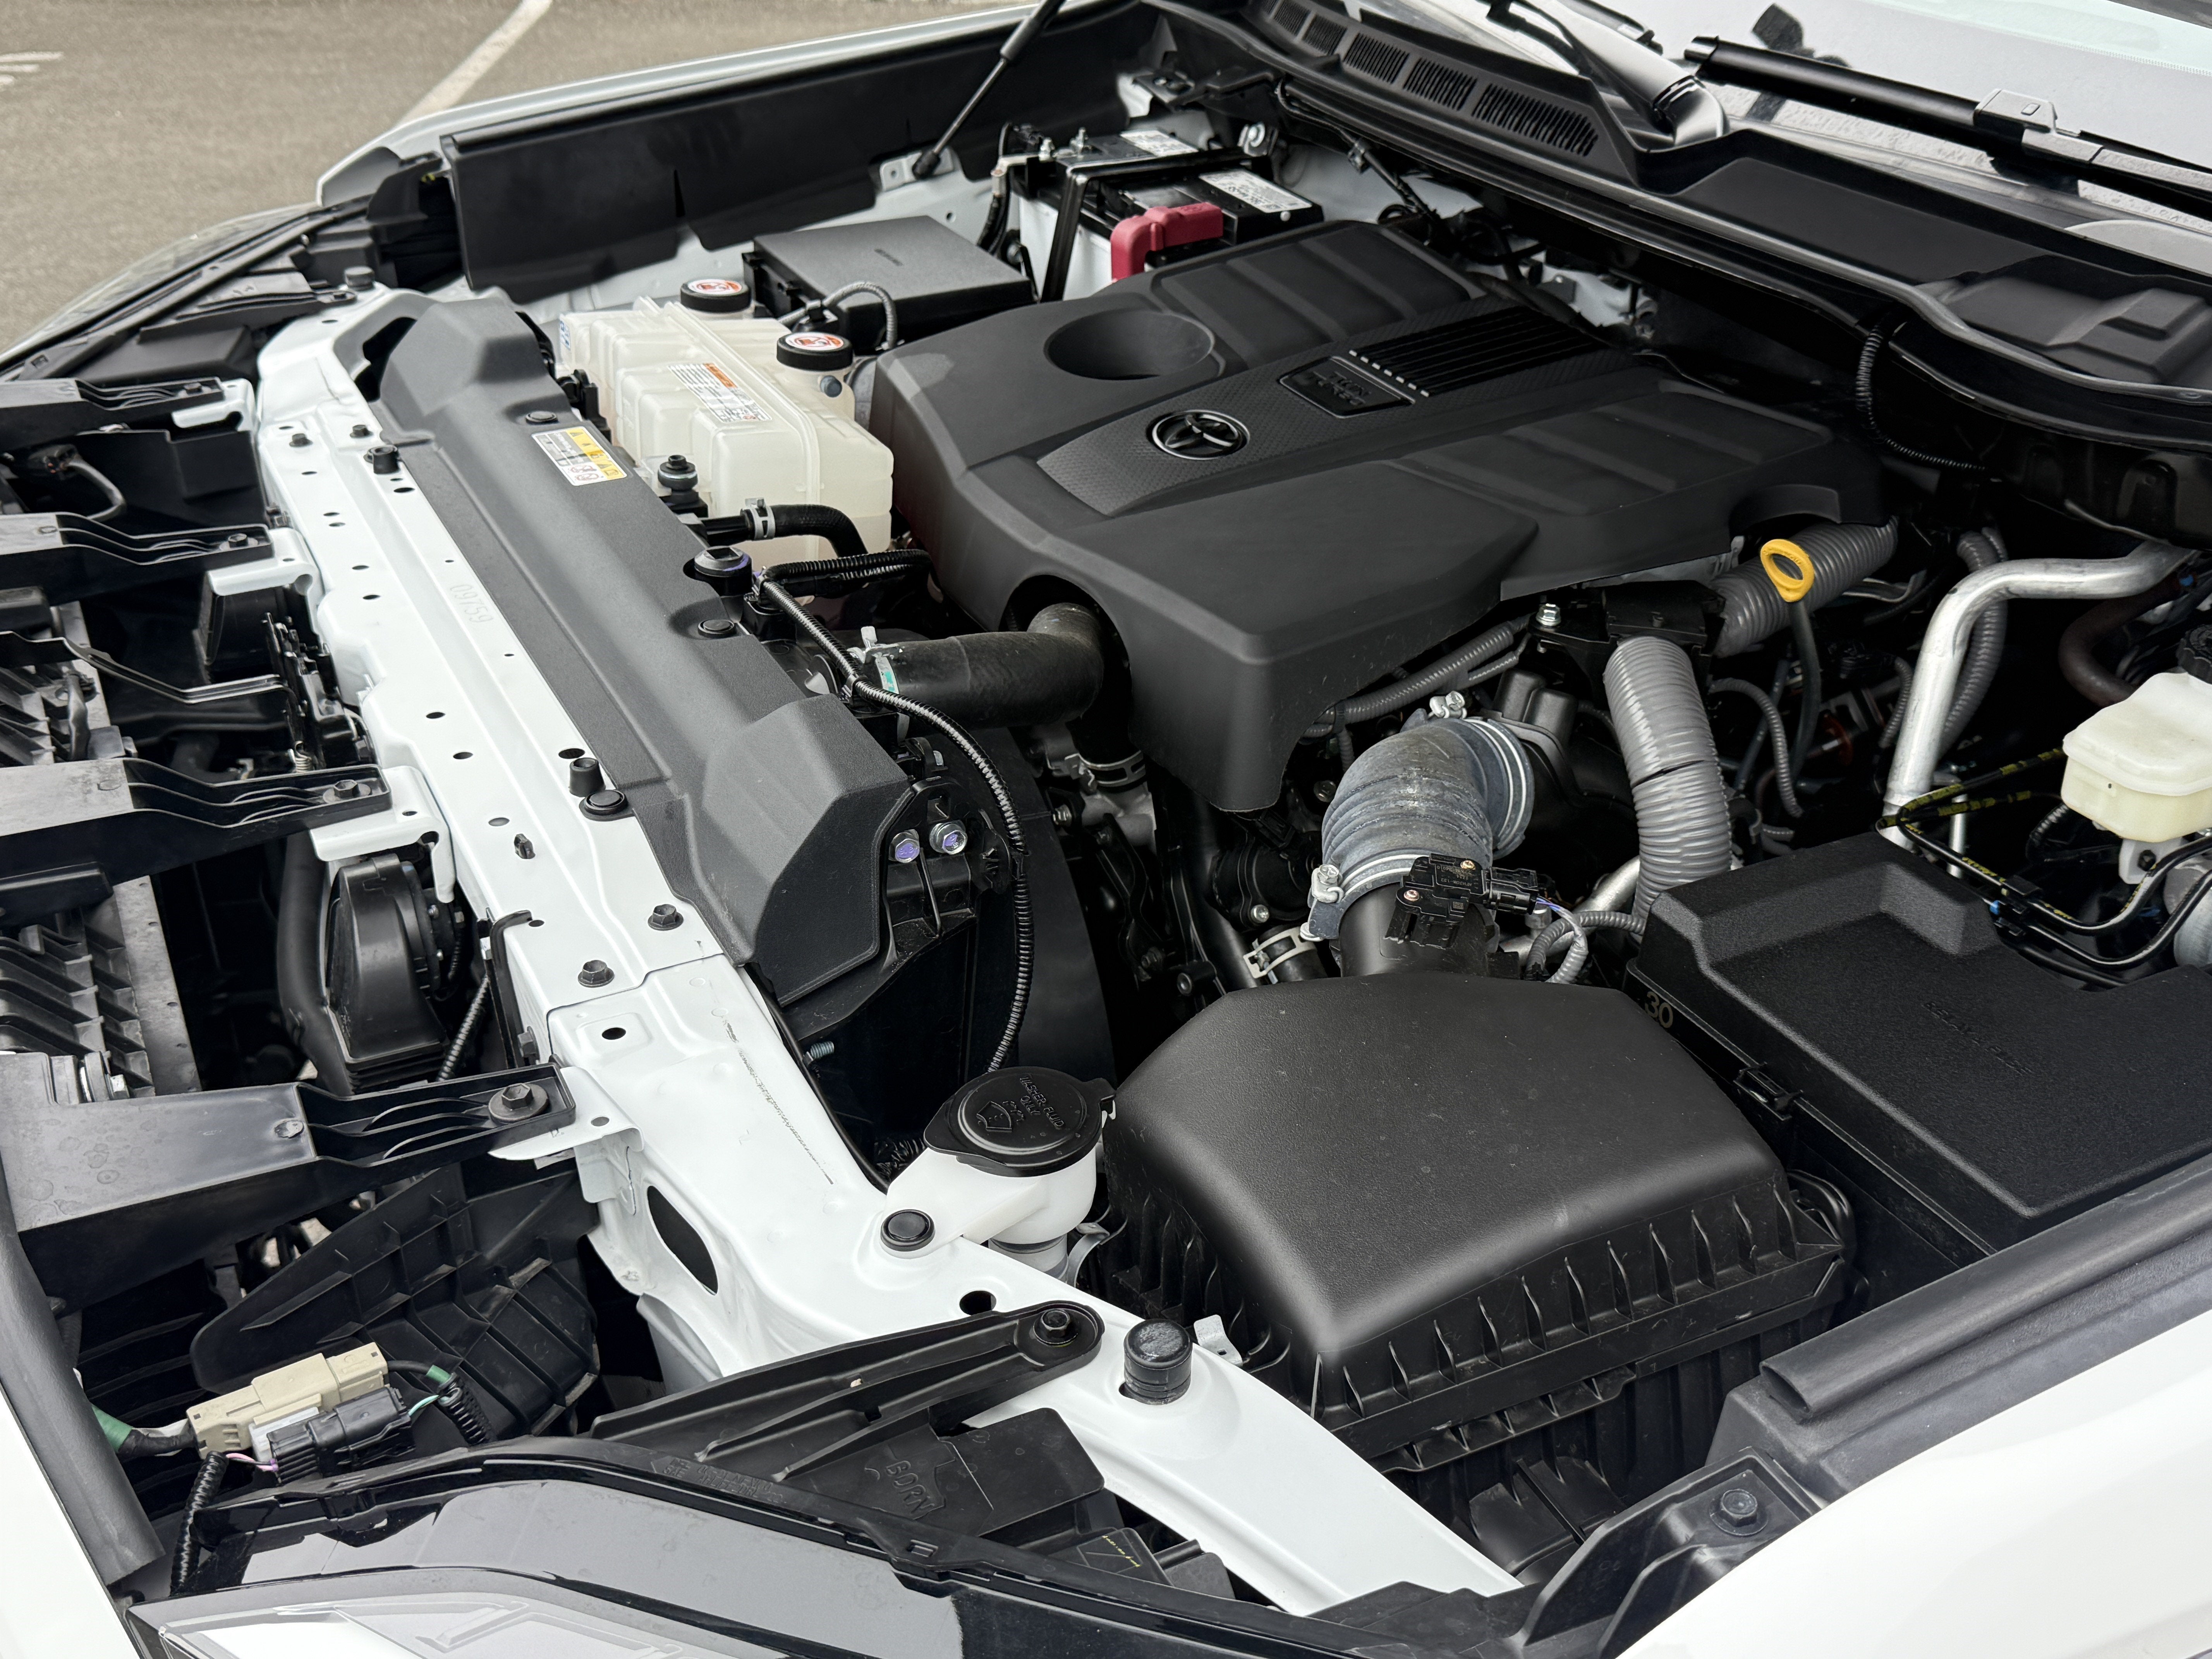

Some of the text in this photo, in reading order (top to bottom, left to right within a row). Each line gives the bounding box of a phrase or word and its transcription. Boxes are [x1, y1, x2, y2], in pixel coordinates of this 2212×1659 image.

[450, 584, 493, 623] 09759
[1645, 991, 1674, 1029] 30
[1019, 1075, 1065, 1130] WASHER FLUID
[1020, 1095, 1041, 1116] ONLY
